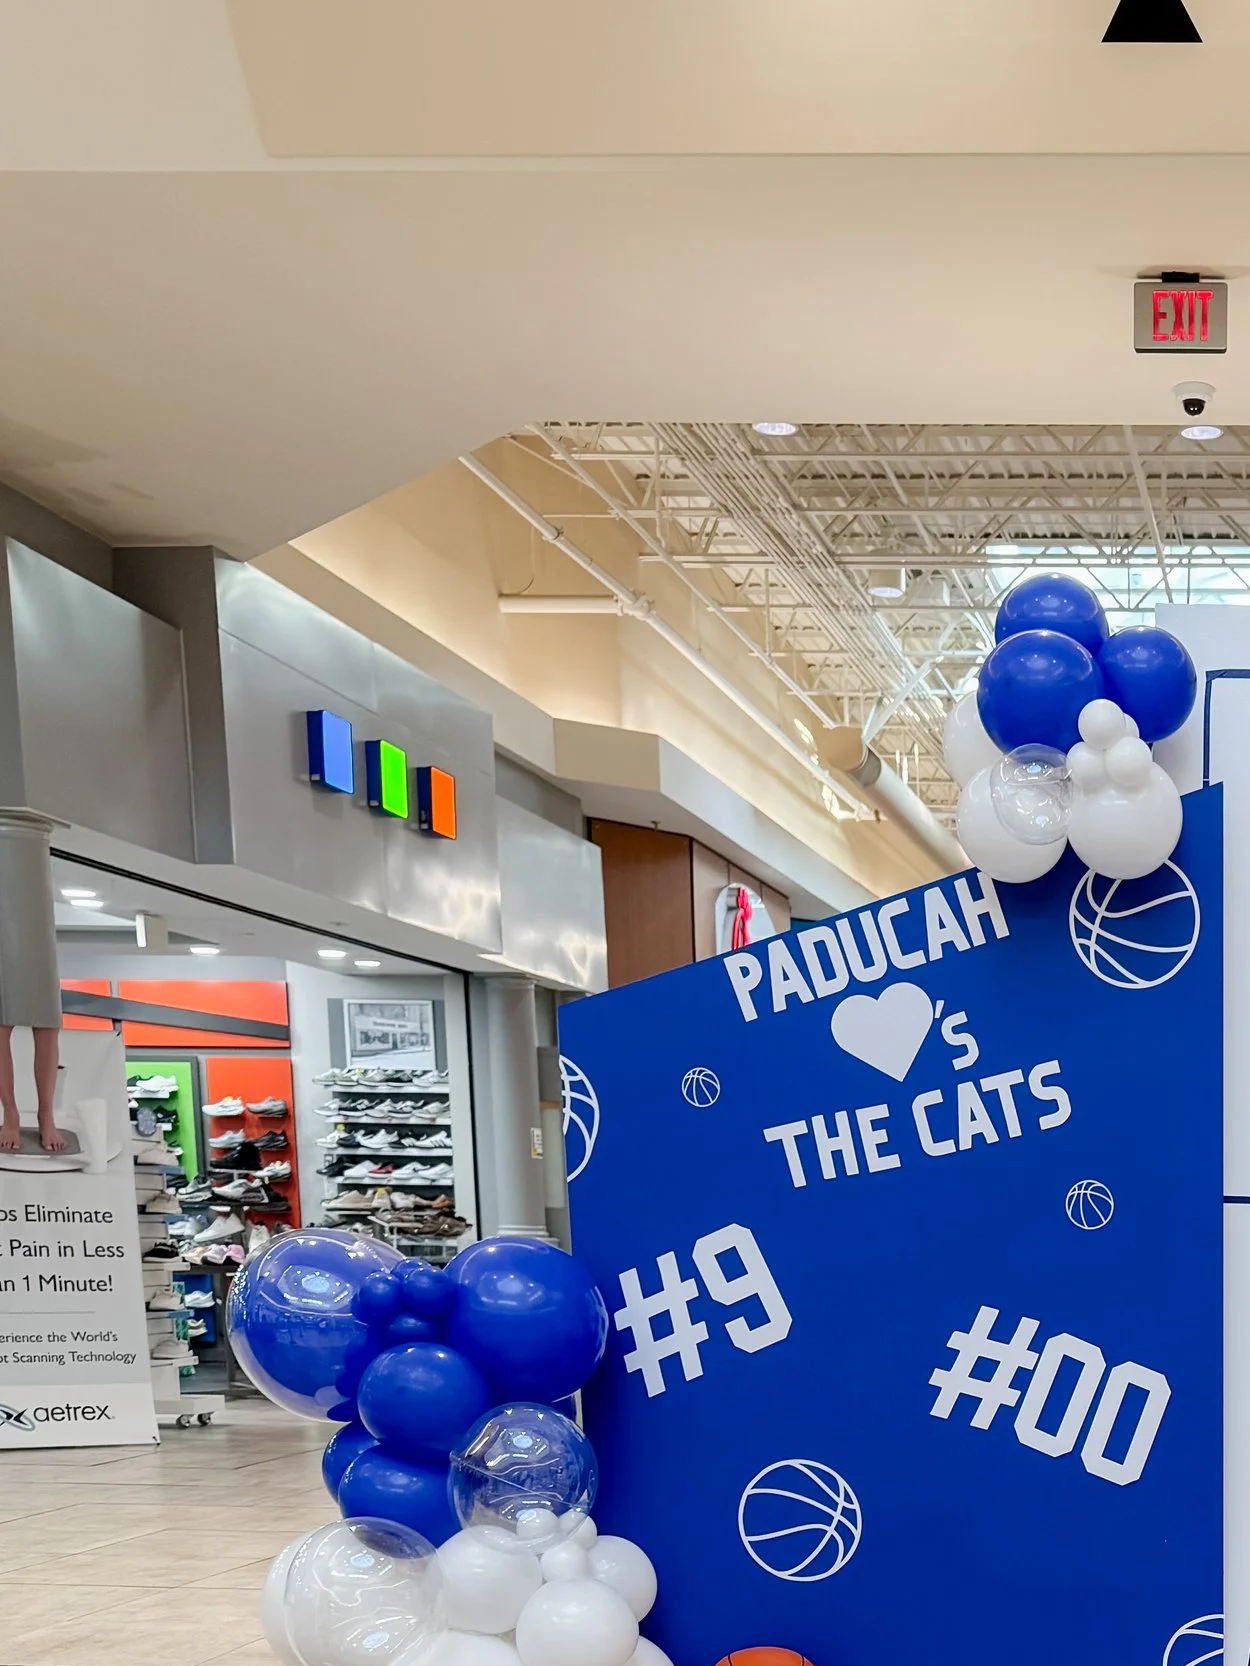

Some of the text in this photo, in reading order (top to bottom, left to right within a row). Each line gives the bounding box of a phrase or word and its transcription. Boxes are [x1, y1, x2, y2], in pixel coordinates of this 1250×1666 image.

[1152, 290, 1214, 342] EXIT
[723, 871, 1010, 1023] PADUCAH
[763, 1060, 1072, 1188] THE CATS
[24, 1204, 114, 1223] Eliminate
[9, 1238, 50, 1258] Pain
[57, 1240, 75, 1258] in
[82, 1239, 125, 1258] Less
[22, 1274, 30, 1292] 1
[38, 1274, 113, 1292] Minute!
[614, 1223, 792, 1398] #9
[47, 1331, 67, 1343] the
[70, 1331, 119, 1342] World's
[12, 1351, 66, 1366] Scanning
[68, 1350, 137, 1365] Technology
[928, 1305, 1172, 1486] #00
[33, 1403, 112, 1422] aetrex
